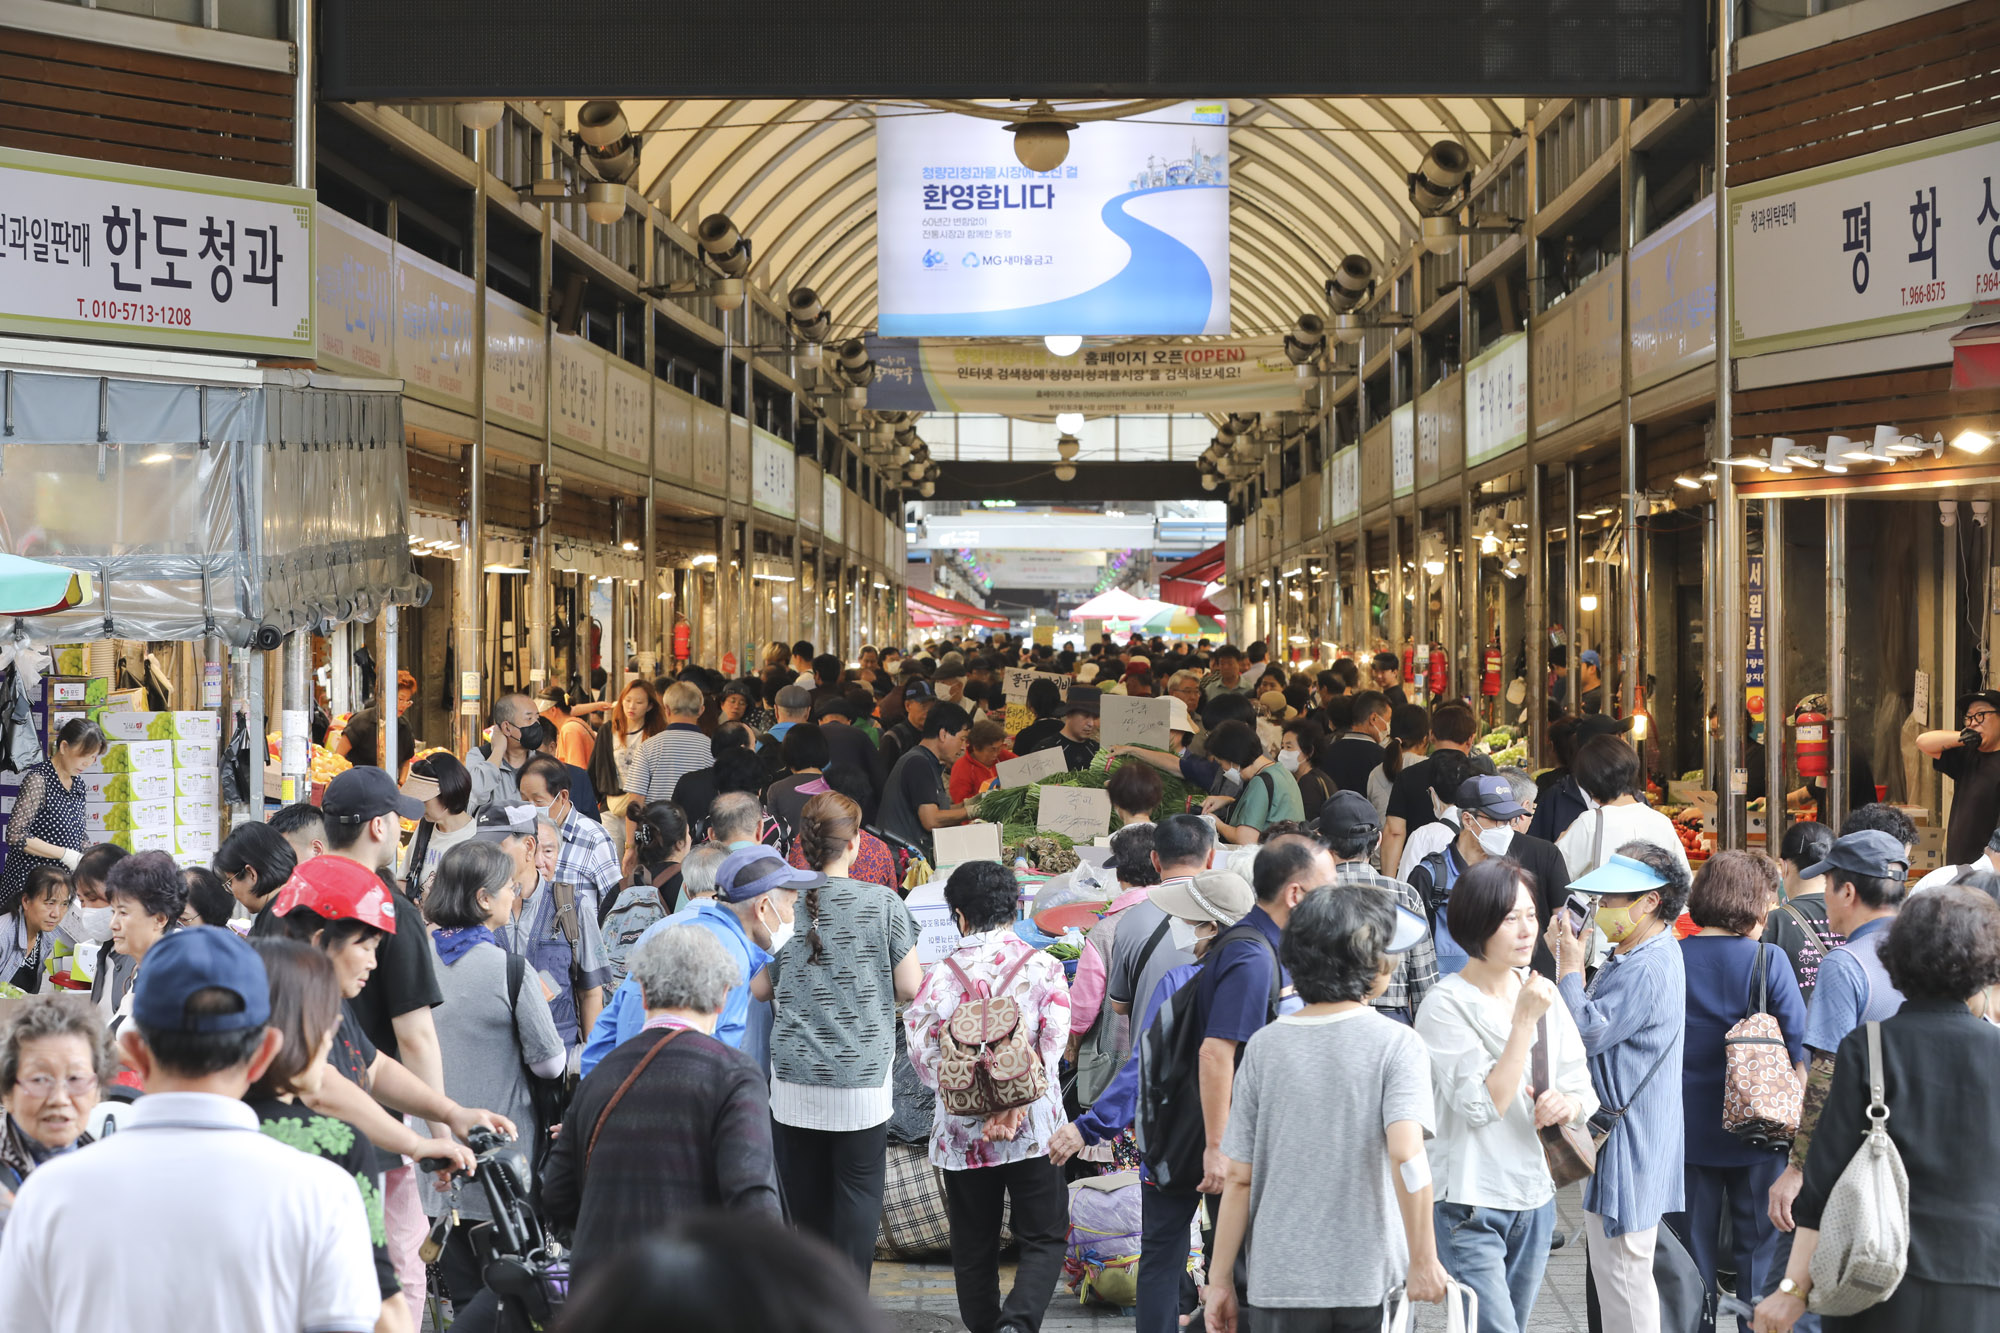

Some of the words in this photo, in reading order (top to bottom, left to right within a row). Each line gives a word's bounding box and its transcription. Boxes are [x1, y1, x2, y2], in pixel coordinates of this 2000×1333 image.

[922, 166, 1034, 179] 청량리청과물시장에
[923, 184, 1055, 210] 환영합니다
[1751, 202, 1796, 233] 청과위탁판매
[102, 205, 283, 306] 한도청과
[982, 256, 1002, 265] MG
[1004, 256, 1053, 265] 새마을금고
[1901, 281, 1946, 306] T.966-8575
[92, 300, 192, 326] 010-5713-1208
[1084, 351, 1146, 365] 홈페이지
[957, 367, 993, 380] 인터넷
[1166, 366, 1242, 381] 검색해보세요!
[1036, 390, 1065, 399] 홈페이지
